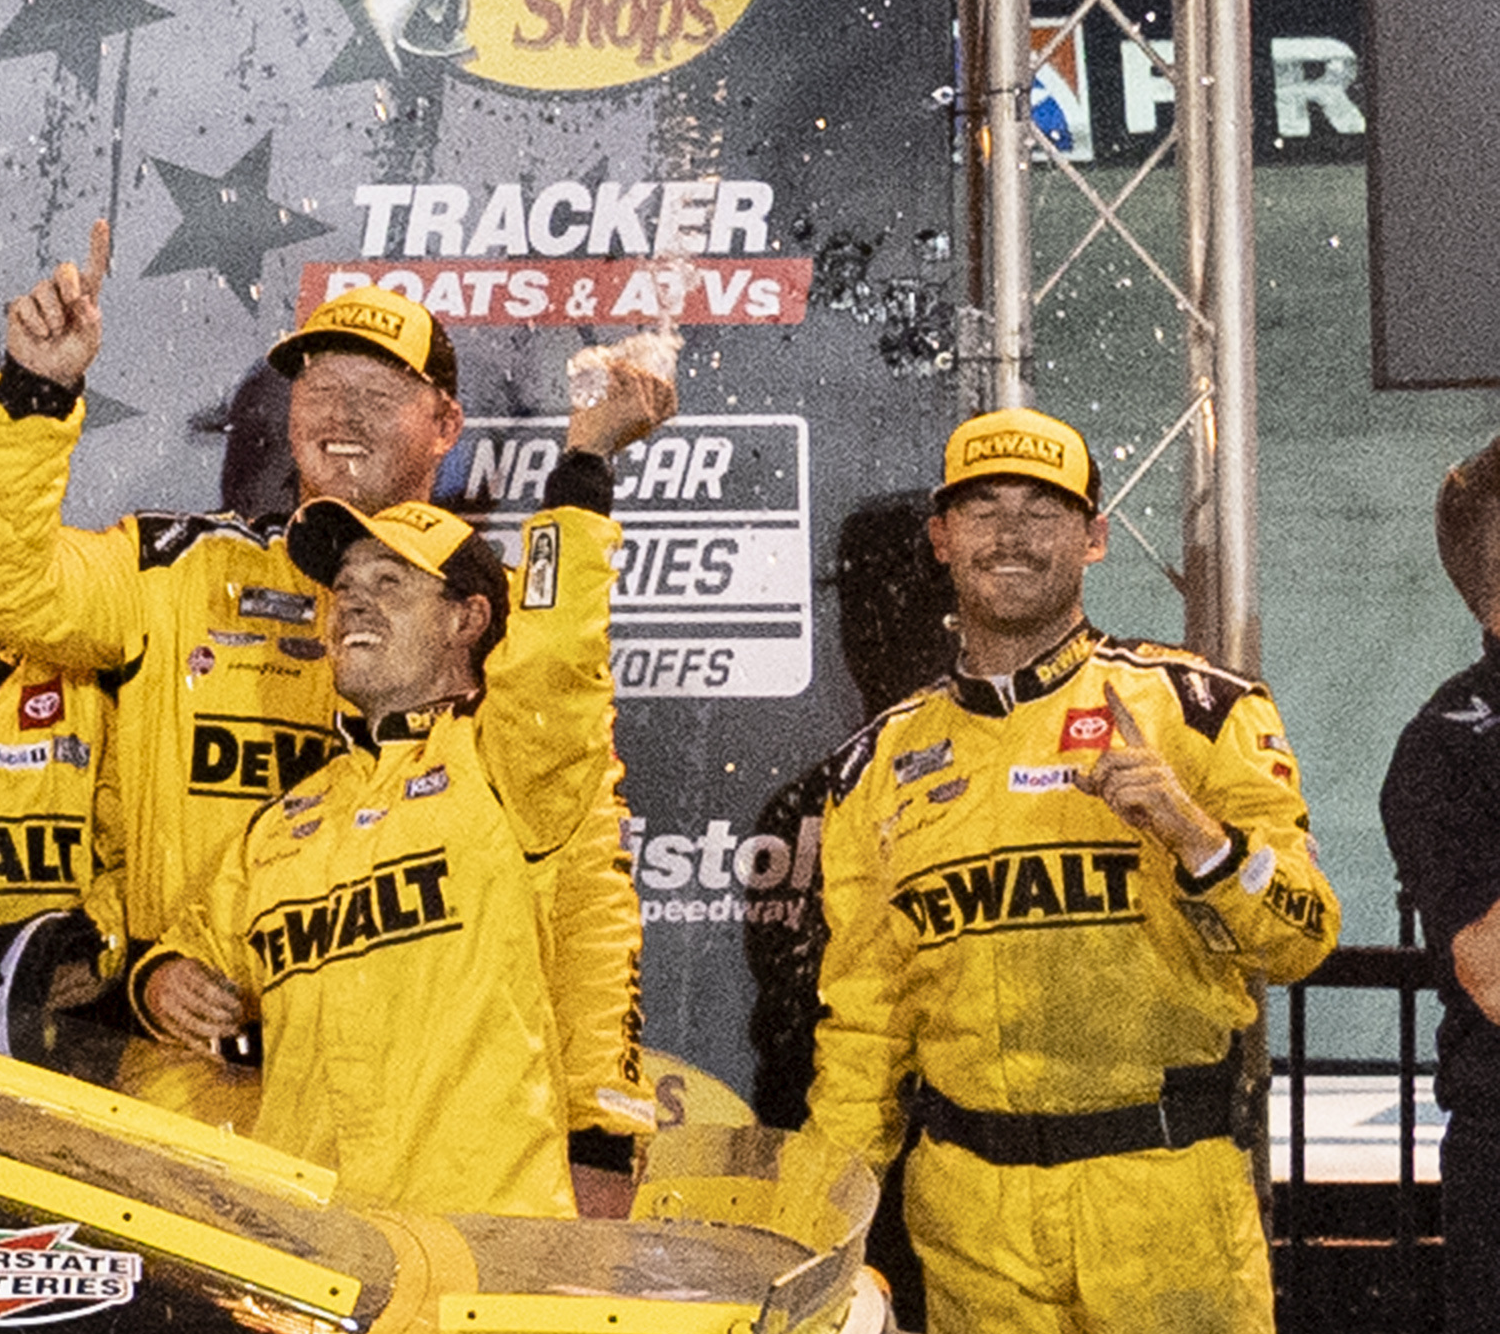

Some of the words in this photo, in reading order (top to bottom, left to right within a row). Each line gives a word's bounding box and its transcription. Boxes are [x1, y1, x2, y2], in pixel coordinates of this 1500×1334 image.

[354, 180, 773, 257] TRACKER
[565, 278, 597, 318] &
[610, 268, 781, 316] ATVs
[464, 436, 734, 501] NACAR
[187, 722, 333, 788] DEW
[640, 894, 805, 932] peedway
